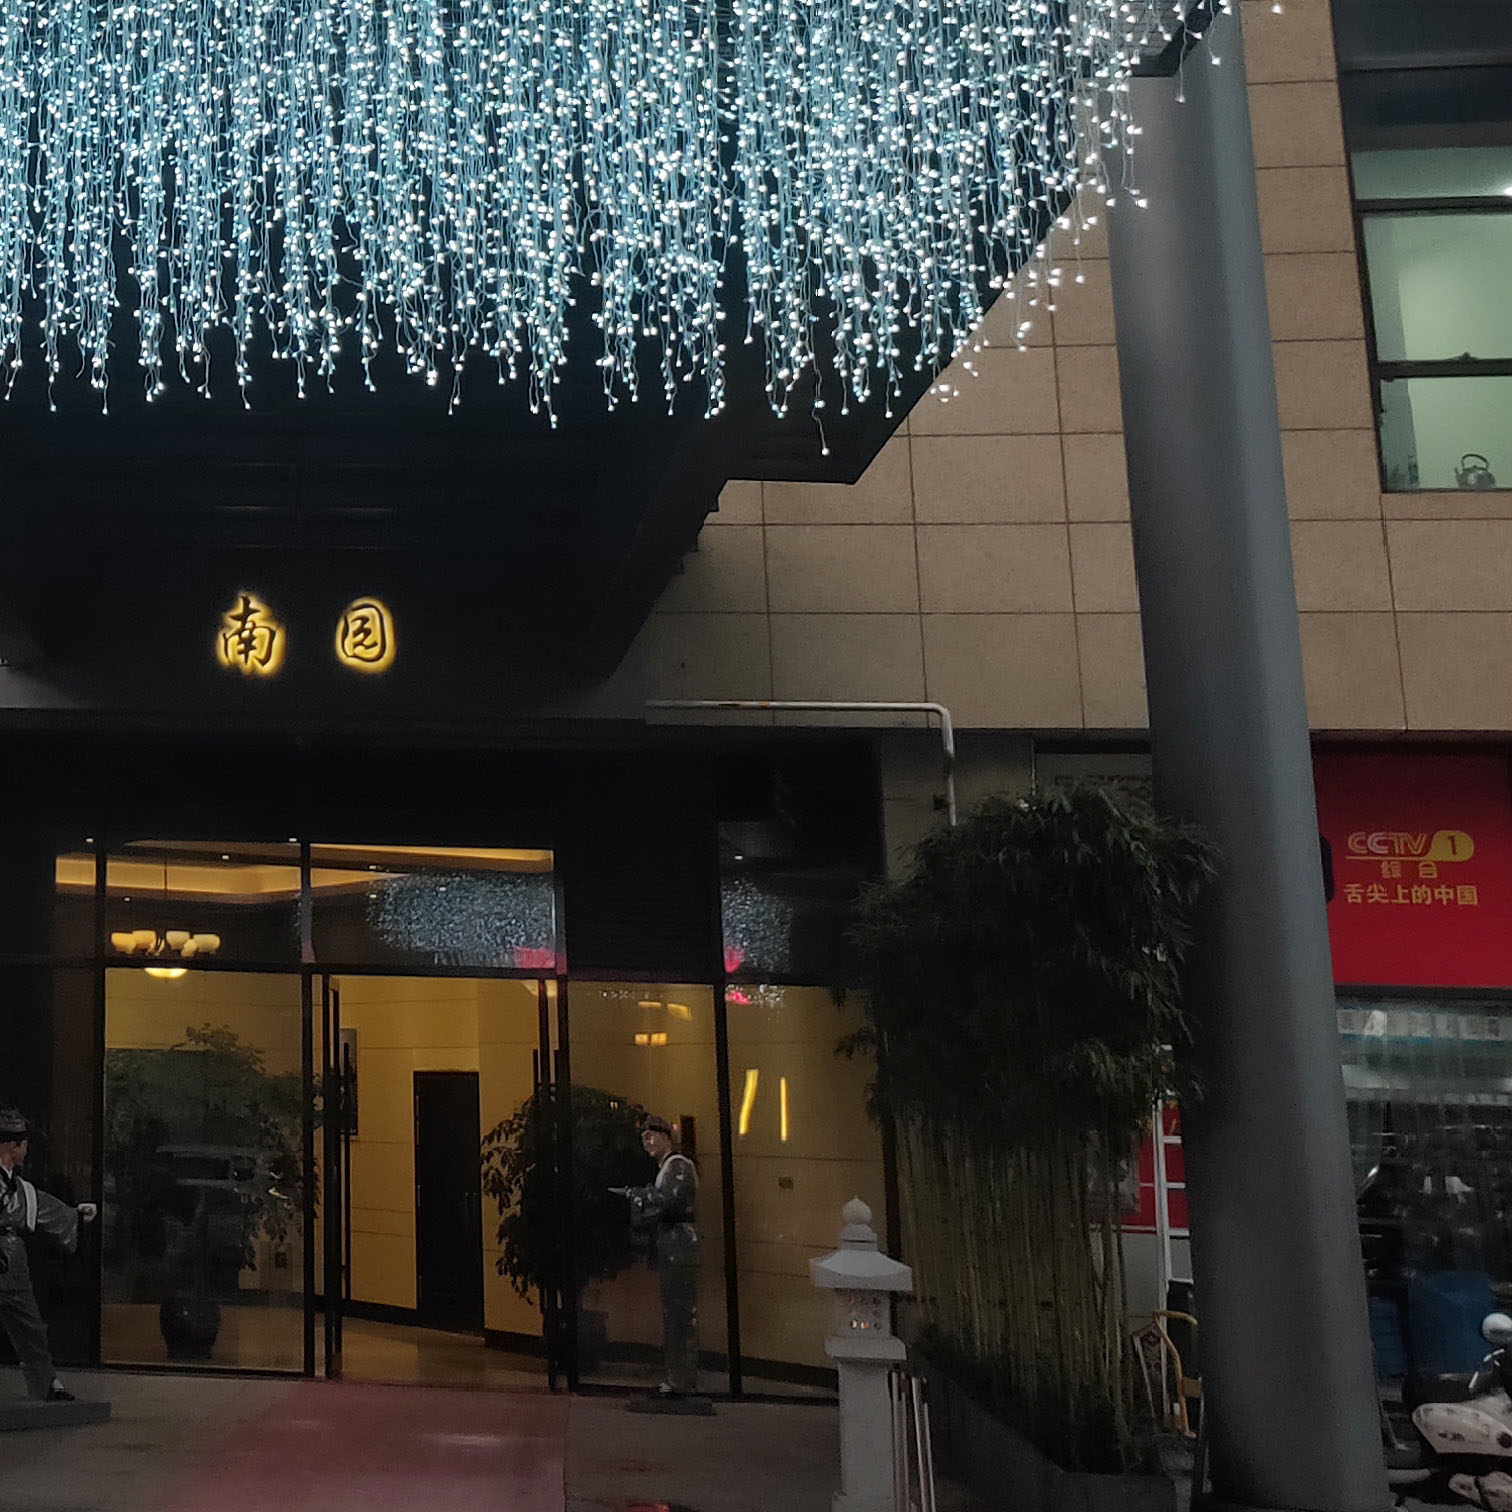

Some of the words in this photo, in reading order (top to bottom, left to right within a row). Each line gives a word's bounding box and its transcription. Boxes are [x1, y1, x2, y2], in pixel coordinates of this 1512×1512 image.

[1347, 831, 1427, 855] CCTV
[1343, 883, 1479, 906] 舌尖上的中国
